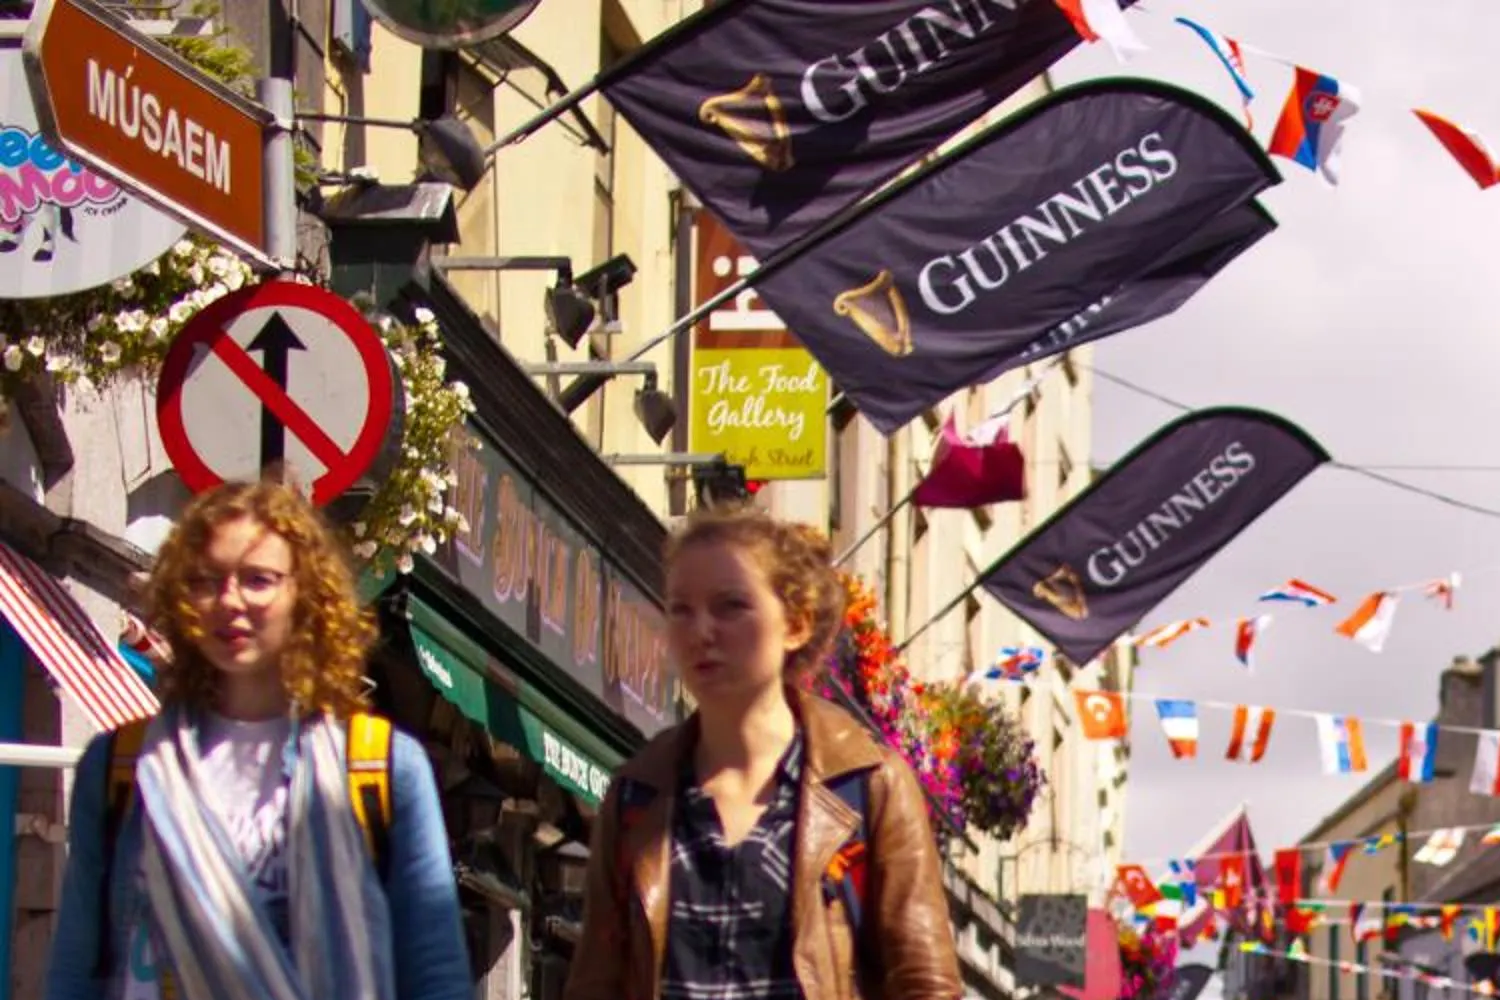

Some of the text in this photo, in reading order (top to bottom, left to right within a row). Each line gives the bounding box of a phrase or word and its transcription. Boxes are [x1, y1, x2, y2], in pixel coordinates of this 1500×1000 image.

[87, 57, 231, 195] MÚSAEM
[917, 132, 1180, 316] GUINNESS
[698, 359, 820, 396] The Food
[707, 395, 806, 442] Gallery
[1087, 441, 1256, 587] GUINNESS
